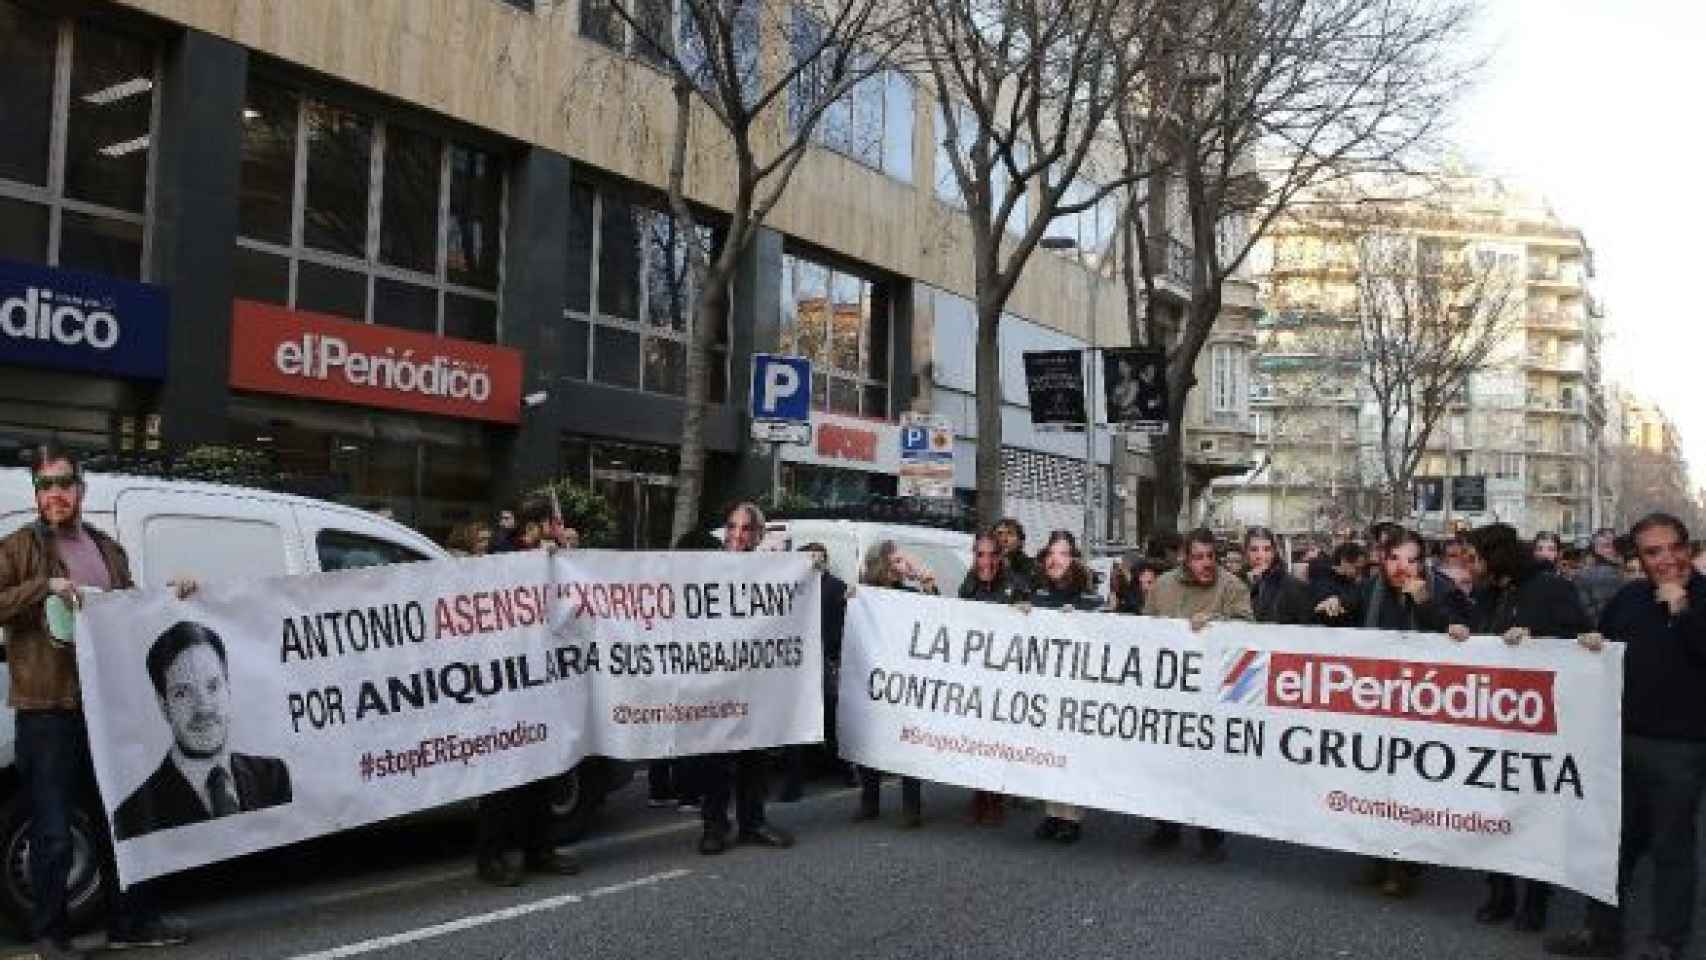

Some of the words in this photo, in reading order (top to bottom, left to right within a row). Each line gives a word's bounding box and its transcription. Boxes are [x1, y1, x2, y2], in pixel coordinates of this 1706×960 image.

[763, 363, 800, 412] P
[907, 427, 921, 447] P
[280, 600, 426, 663] ANTONIO
[684, 583, 721, 618] DE
[908, 620, 950, 663] LA
[961, 629, 1143, 687] PLANTILLA
[1153, 648, 1203, 692] DE
[288, 685, 345, 732] POR
[609, 641, 655, 675] SUS
[360, 720, 547, 781] #stopEREperiodico
[868, 667, 983, 719] CONTRA
[991, 687, 1047, 728] LOS
[1057, 696, 1215, 751] RECORTES
[1224, 716, 1265, 757] EN
[1278, 725, 1457, 783] GRUPO
[1463, 746, 1584, 800] ZETA
[1327, 790, 1512, 835] @comiteperiodico
